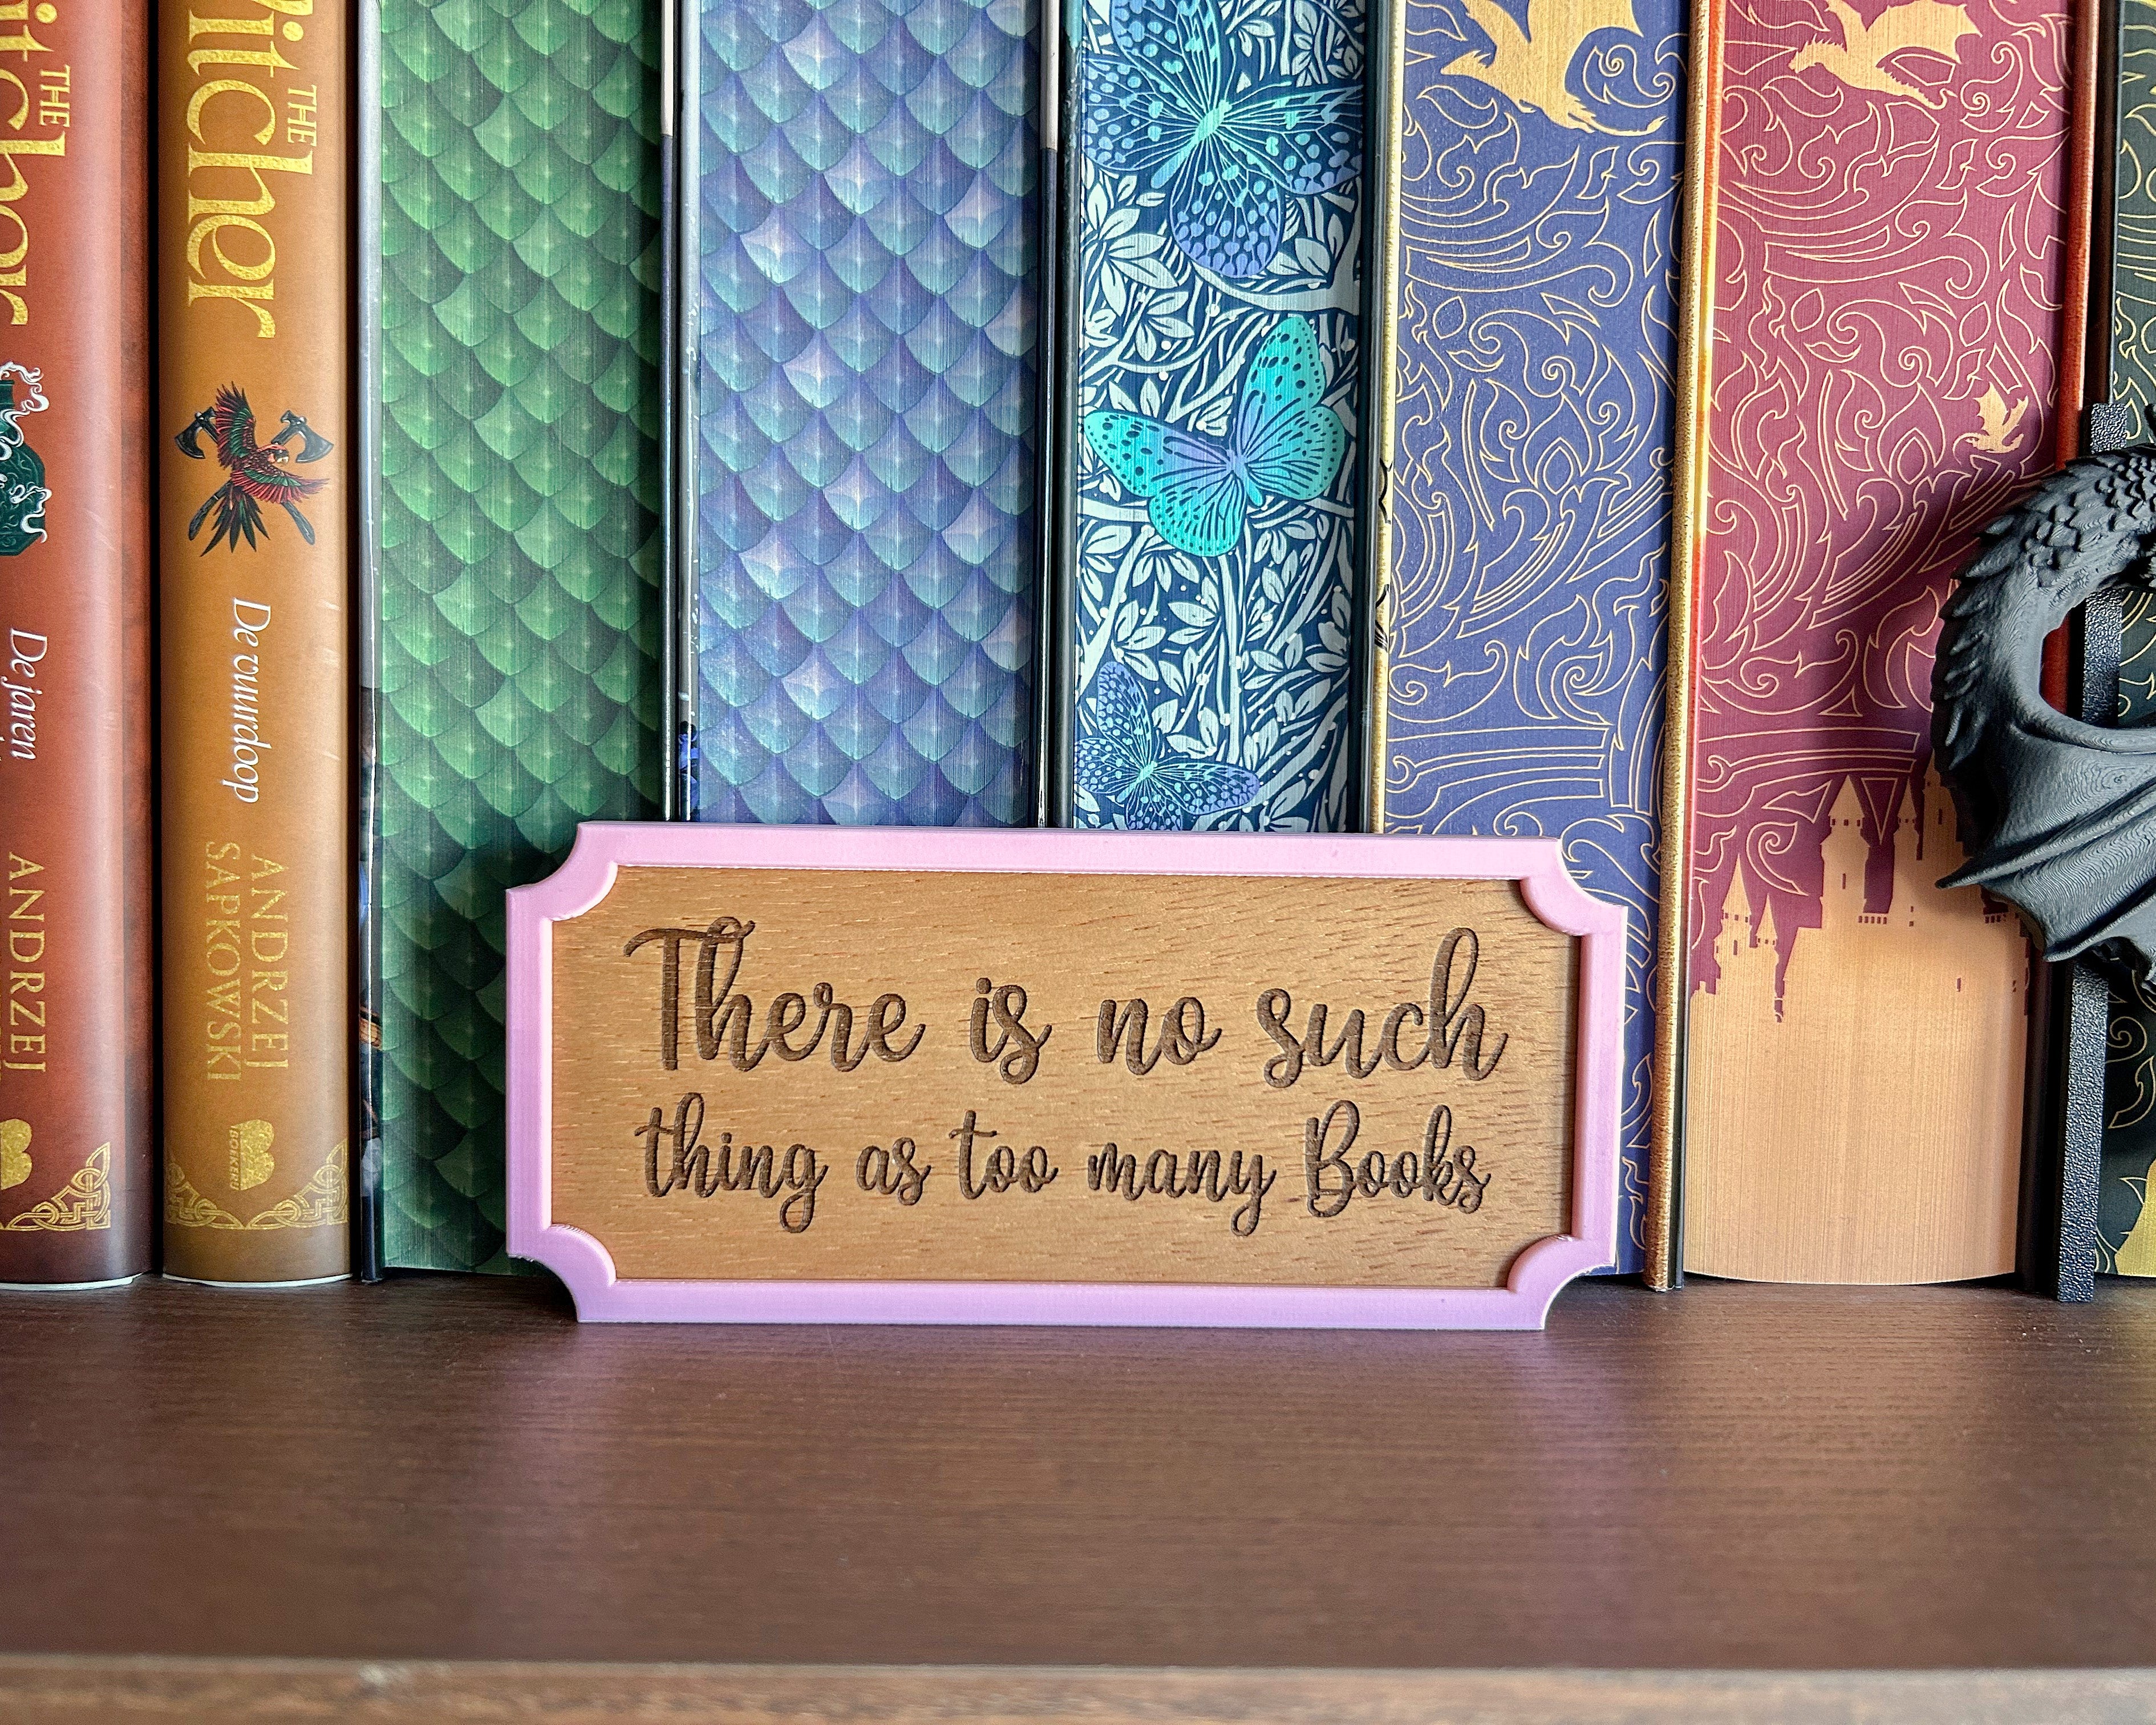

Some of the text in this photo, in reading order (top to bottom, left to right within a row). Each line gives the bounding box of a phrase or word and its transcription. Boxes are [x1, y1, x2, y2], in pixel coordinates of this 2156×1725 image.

[39, 64, 71, 128] THE
[187, 0, 313, 338] itcher
[287, 84, 318, 147] THE
[0, 627, 48, 761] De jaren
[221, 597, 273, 804] De vuurdoop
[3, 852, 46, 1072] ANDRZEJ
[205, 841, 242, 1081] SAPKOWSKI
[245, 855, 289, 1068] ANDRZEJ
[623, 916, 1509, 1088] There is no such
[634, 1092, 1492, 1237] thing as too many Books
